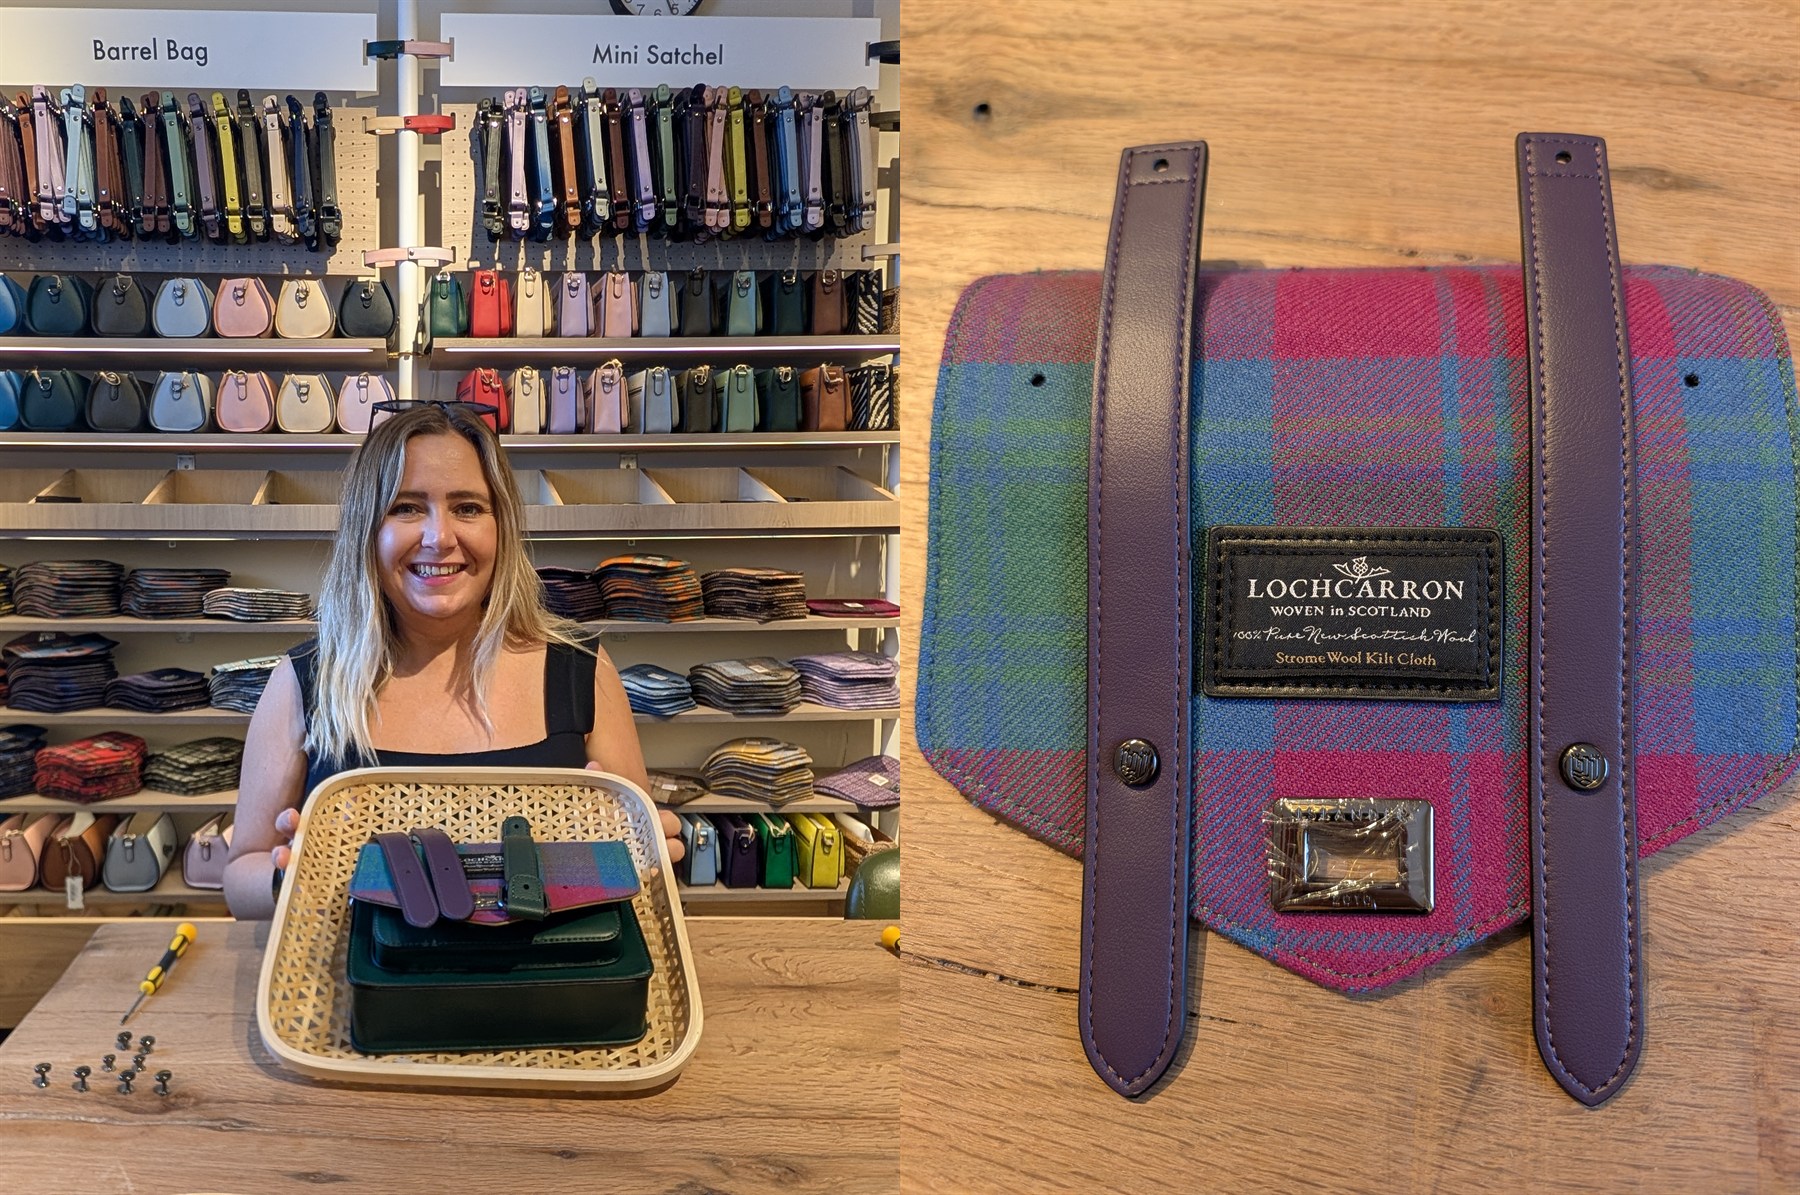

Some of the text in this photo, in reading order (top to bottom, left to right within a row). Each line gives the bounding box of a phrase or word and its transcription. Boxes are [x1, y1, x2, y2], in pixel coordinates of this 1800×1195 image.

[93, 37, 208, 67] Barrel Bag
[592, 43, 723, 65] Mini Satchel
[1247, 578, 1465, 600] LOCHCARRON
[1270, 605, 1431, 618] WOVEN in SCOTLAND
[1233, 625, 1477, 645] 100% Pure New Scottish Wool
[1275, 651, 1436, 667] Strome Wool Kilt Cloth
